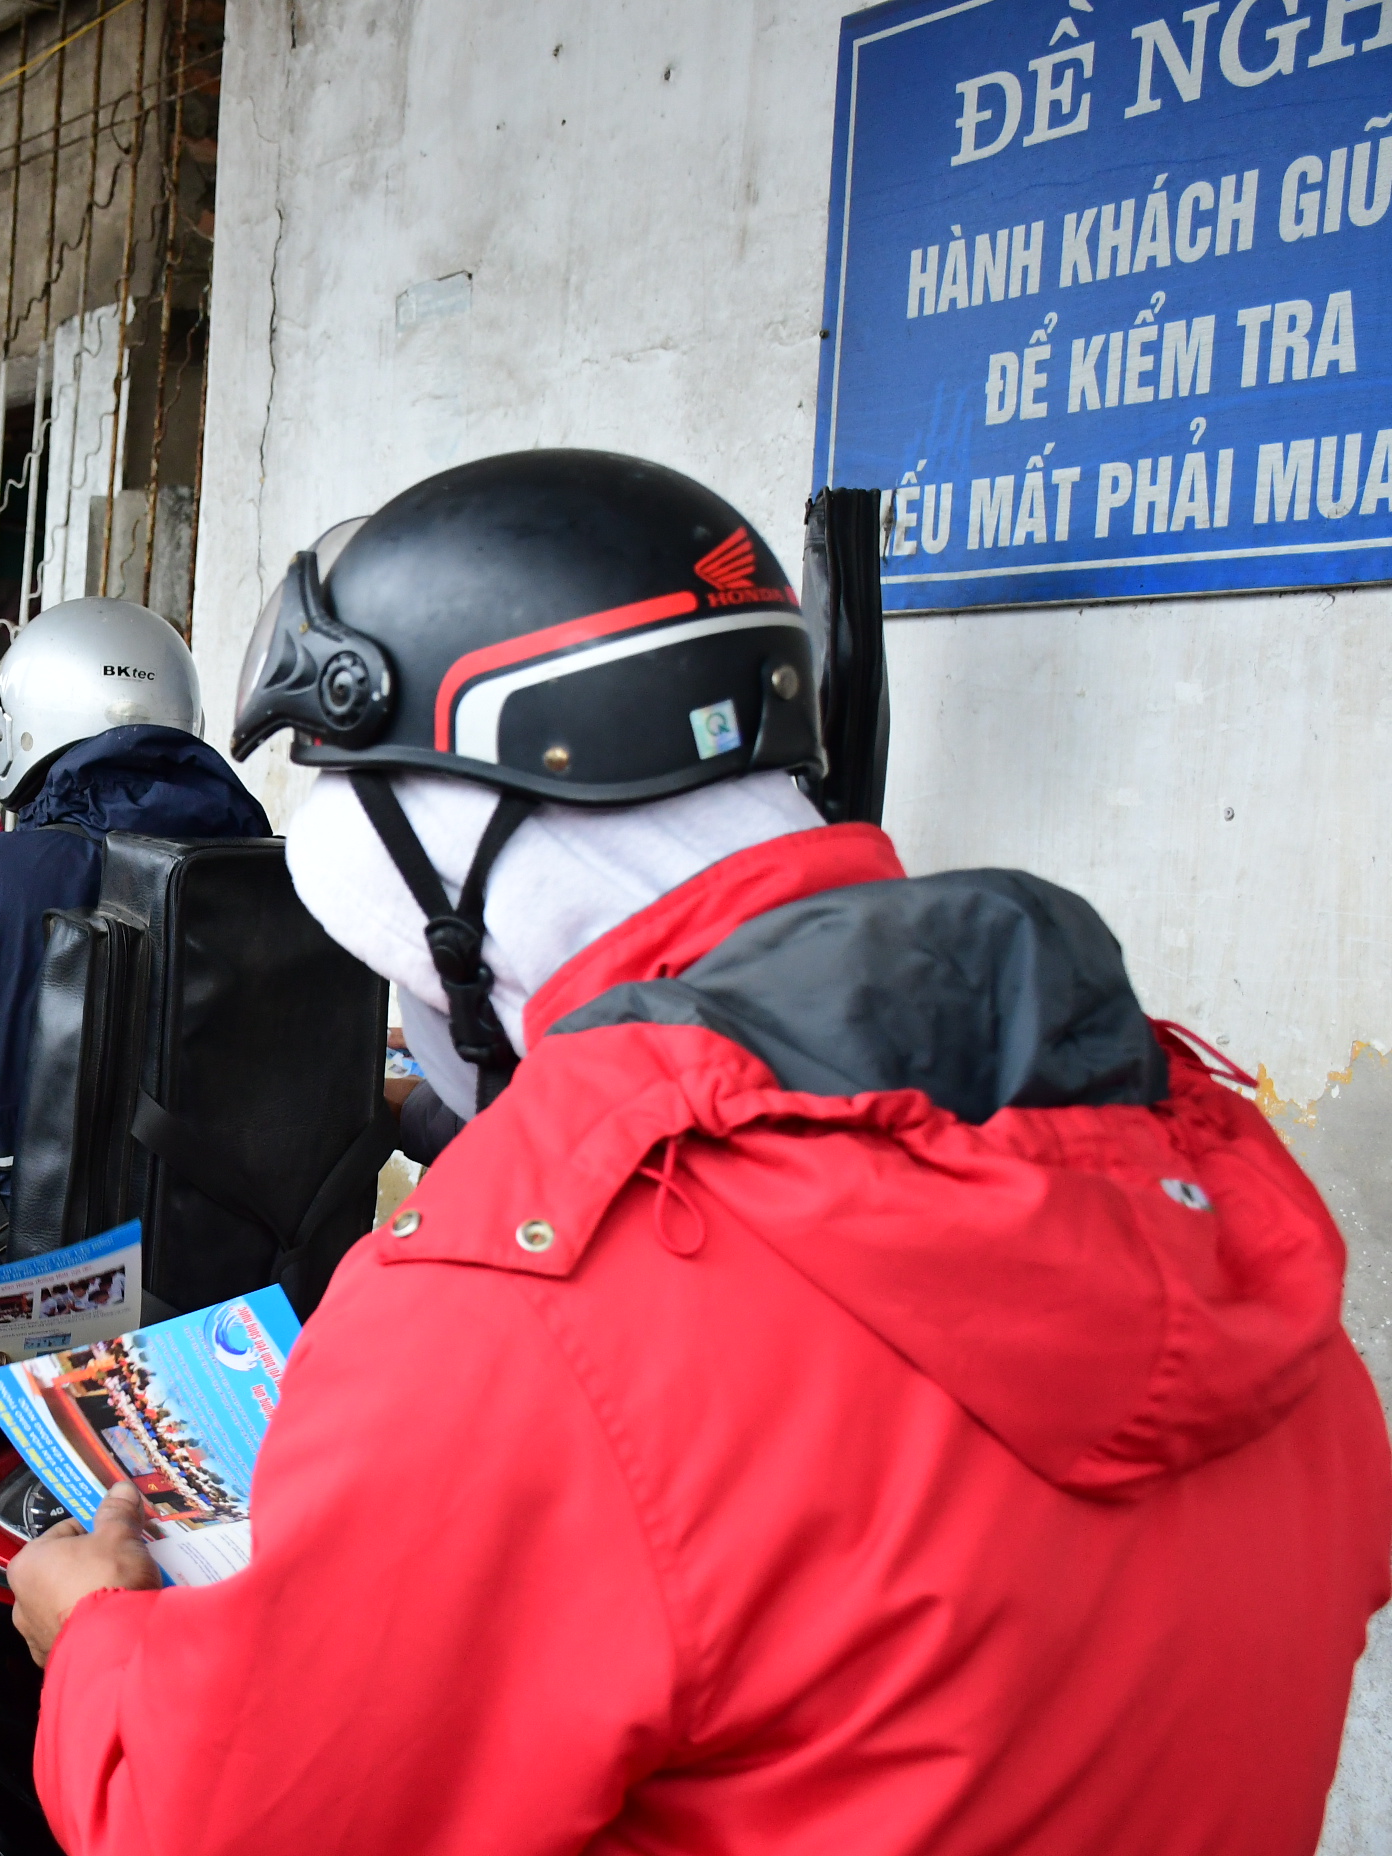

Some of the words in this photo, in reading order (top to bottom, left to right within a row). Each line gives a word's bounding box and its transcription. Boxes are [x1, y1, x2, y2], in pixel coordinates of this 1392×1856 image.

[951, 0, 1095, 166] ĐỀ
[907, 221, 1044, 318] HÀNH
[1059, 170, 1258, 289] KHÁCH
[985, 312, 1057, 425] ĐỂ
[1067, 291, 1215, 414] KIỂM
[1236, 290, 1357, 389] TRA
[966, 442, 1080, 550] MẤT
[1095, 417, 1234, 538] PHẢI
[1253, 429, 1392, 524] MUA
[705, 587, 786, 608] HONDA
[103, 665, 156, 681] BKtec
[50, 1507, 64, 1516] 40
